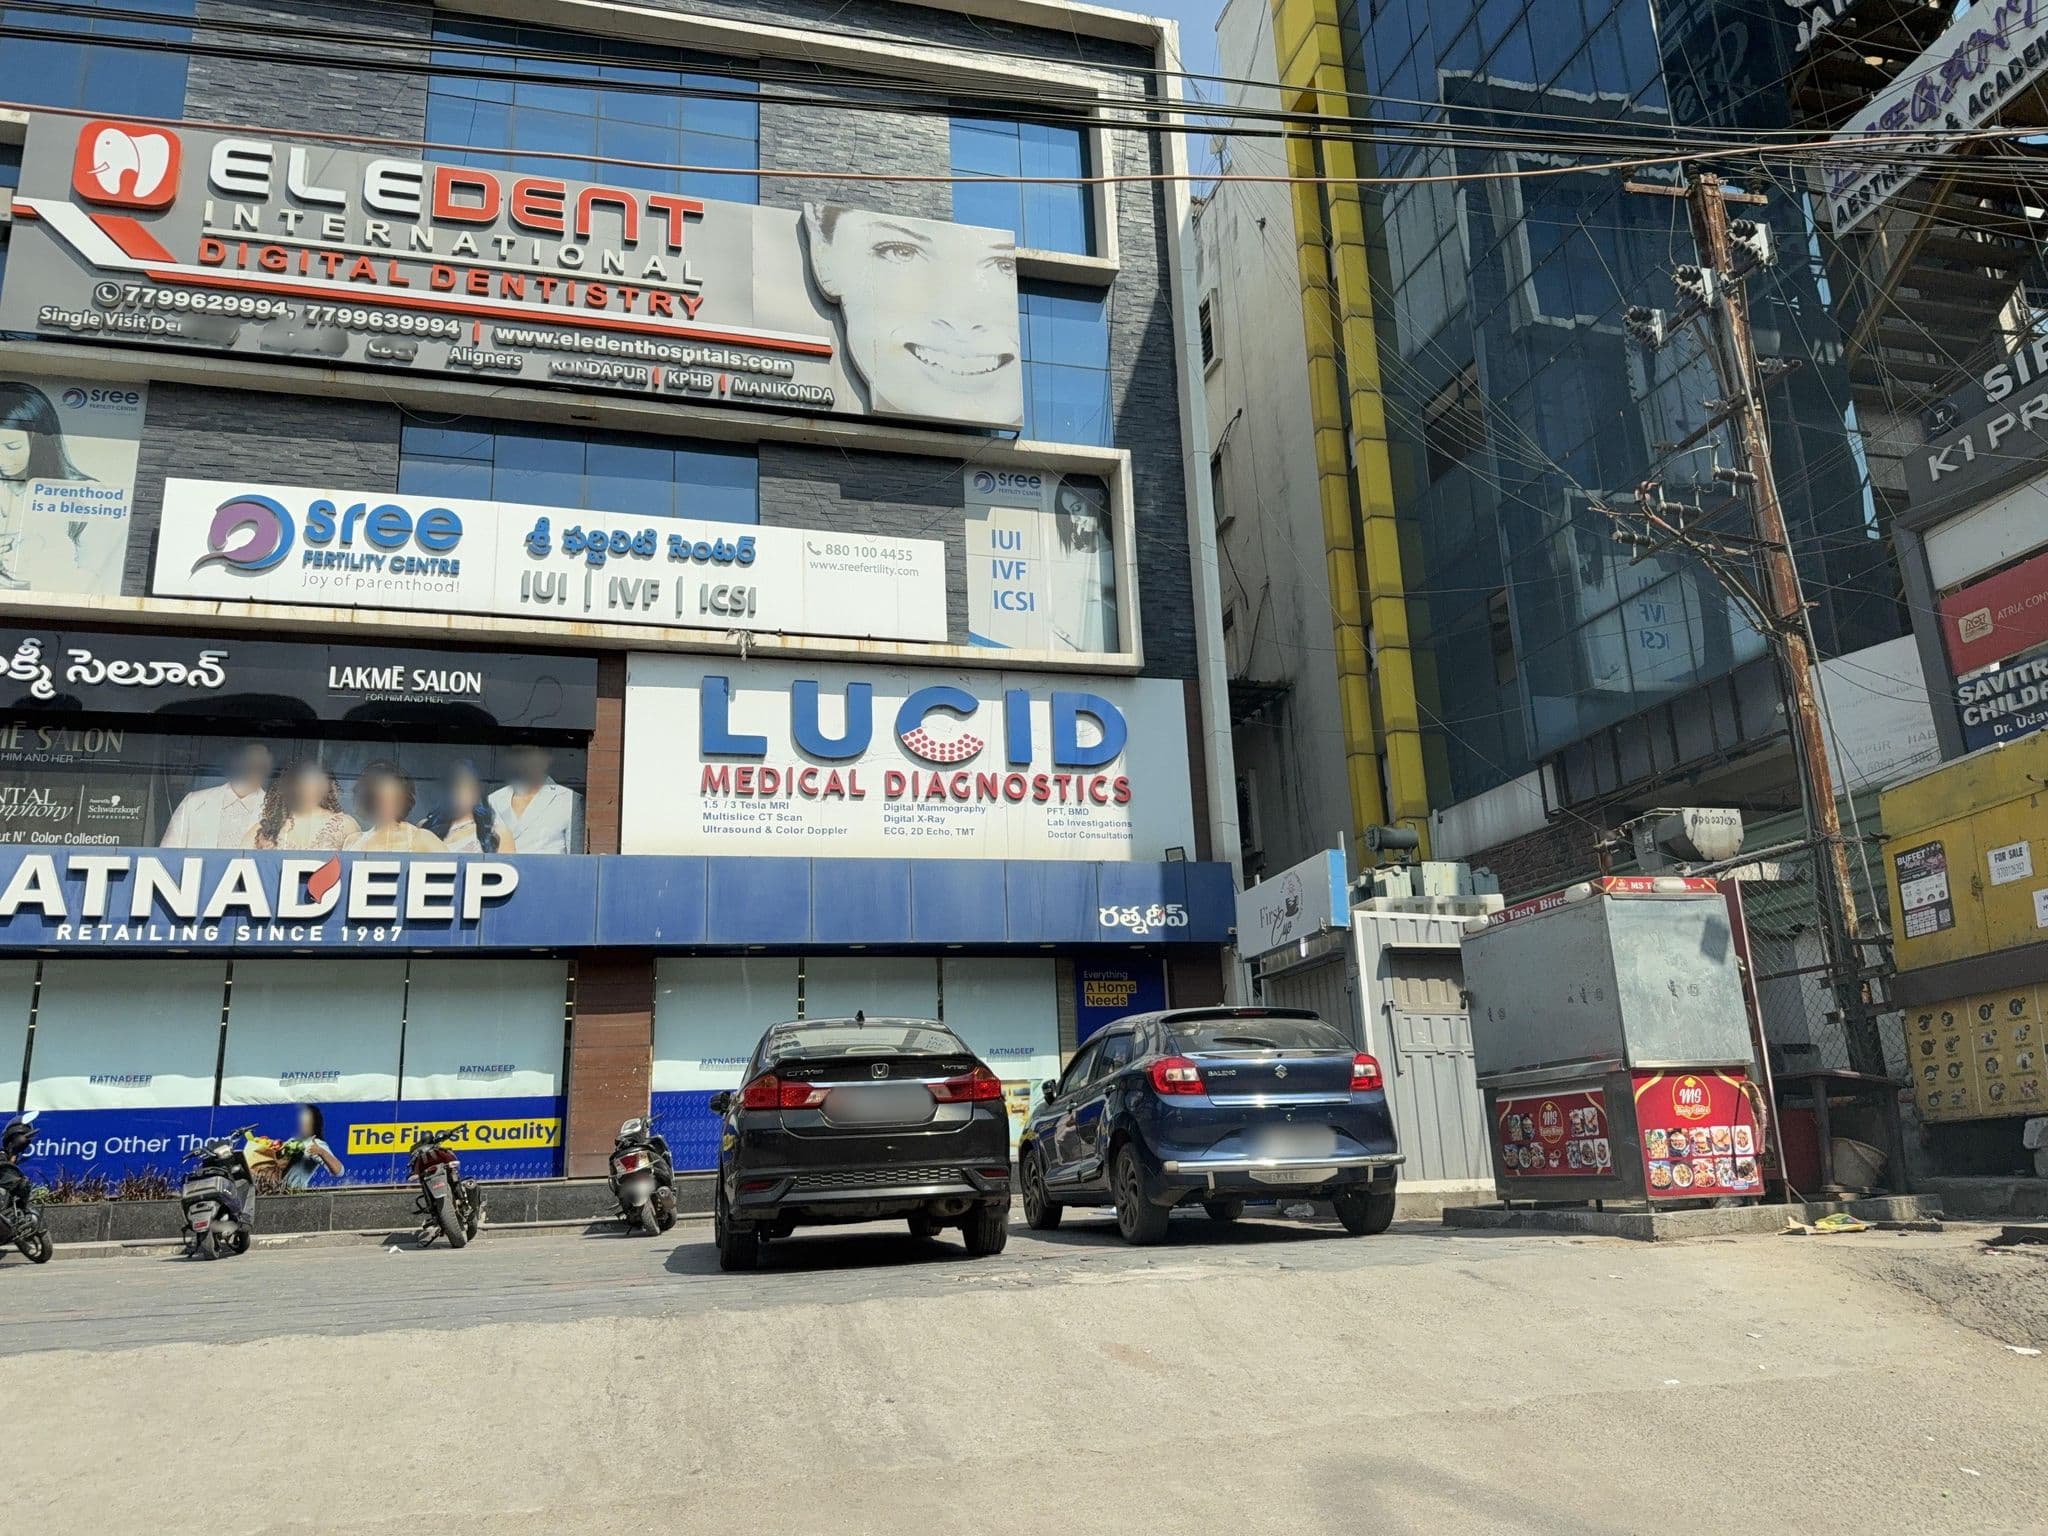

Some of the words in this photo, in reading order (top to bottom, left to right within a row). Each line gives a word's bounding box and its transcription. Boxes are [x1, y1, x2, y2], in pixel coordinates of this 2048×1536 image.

[1945, 111, 1960, 130] &
[209, 138, 705, 250] ELEDENT
[202, 200, 703, 285] INTERNATIONAL
[199, 237, 410, 288] DIGITAL
[431, 263, 704, 320] DENTISTRY
[39, 306, 100, 330] Single
[104, 312, 147, 330] Visit
[306, 304, 460, 335] 7799639994
[449, 346, 523, 368] Aligners
[495, 326, 793, 371] www.eledenthospitals.com
[668, 370, 714, 389] KPHB
[734, 377, 834, 402] MANIKONDA
[90, 388, 139, 404] sree
[1928, 434, 1976, 482] K1
[998, 472, 1042, 490] sree
[34, 483, 124, 501] Parenthood
[32, 499, 44, 512] is
[47, 503, 56, 512] a
[60, 501, 127, 520] blessing!
[304, 499, 463, 553] sree
[991, 529, 1021, 551] IUI
[825, 543, 850, 556] 880
[854, 545, 877, 558] 100
[880, 548, 913, 561] 4455
[302, 549, 387, 574] FERTILITY
[389, 555, 460, 580] CENTRE
[809, 561, 919, 577] www.sreefertility.com
[992, 559, 1027, 581] IVF
[302, 572, 329, 589] joy
[334, 573, 352, 588] of
[355, 576, 460, 593] parenthood!
[521, 570, 567, 603] IUI
[608, 576, 660, 610] IVF
[699, 583, 757, 616] ICSI
[993, 589, 1035, 612] ICSI
[1997, 601, 2024, 621] ATRIA
[411, 668, 482, 694] SALON
[365, 693, 385, 702] FOR
[405, 694, 424, 703] AND
[701, 674, 1128, 768] LUCID
[1993, 722, 2013, 737] Dr.
[35, 725, 125, 754] SALON
[1, 752, 22, 761] HIM
[24, 753, 50, 763] AND
[51, 754, 74, 763] HER
[700, 764, 867, 799] MEDICAL
[883, 770, 1132, 804] DIAGNOSTICS
[87, 803, 142, 816] Schwarzkopf
[703, 800, 719, 809] 1.5
[730, 801, 737, 809] 3
[741, 800, 767, 810] Tesla
[769, 801, 789, 810] MRI
[883, 803, 915, 815] Digital
[916, 803, 986, 815] Mammography
[1067, 808, 1090, 817] BMD
[702, 811, 755, 822] Multislice
[758, 812, 773, 822] CT
[776, 812, 803, 823] Scan
[883, 814, 915, 826] Digital
[917, 815, 946, 826] X-Ray
[1047, 818, 1065, 828] Lab
[1066, 818, 1133, 829] Investigations
[30, 831, 63, 844] Color
[64, 832, 121, 845] Collection
[702, 824, 761, 835] Ultrasound
[765, 825, 773, 835] &
[776, 825, 804, 835] Color
[807, 826, 848, 837] Doppler
[883, 826, 908, 838] ECG,
[910, 827, 924, 836] 2D
[926, 827, 953, 838] Echo,
[955, 828, 975, 837] TMT
[1047, 830, 1077, 840] Doctor
[1078, 831, 1134, 841] Consultation
[1896, 847, 1926, 867] BUFFET
[1993, 851, 2007, 864] FOR
[2008, 846, 2023, 860] SALE
[1630, 881, 1645, 890] MS
[1489, 910, 1506, 926] MS
[1507, 902, 1538, 921] Tasty
[1539, 896, 1568, 913] Bites
[56, 923, 220, 942] RETAILING
[237, 925, 324, 942] SINCE
[341, 926, 403, 942] 1987
[1083, 970, 1129, 980] Everything
[1086, 982, 1095, 993] A
[1097, 982, 1136, 993] Home
[1086, 994, 1127, 1006] Needs
[989, 1047, 1035, 1056] RATNADEEP
[280, 1070, 341, 1080] RATNADEEP
[459, 1063, 516, 1073] RATNADEEP
[89, 1074, 153, 1084] RATNADEEP
[352, 1128, 395, 1146] The
[475, 1121, 558, 1145] Quality
[22, 1137, 97, 1161] othing
[104, 1134, 171, 1154] Other
